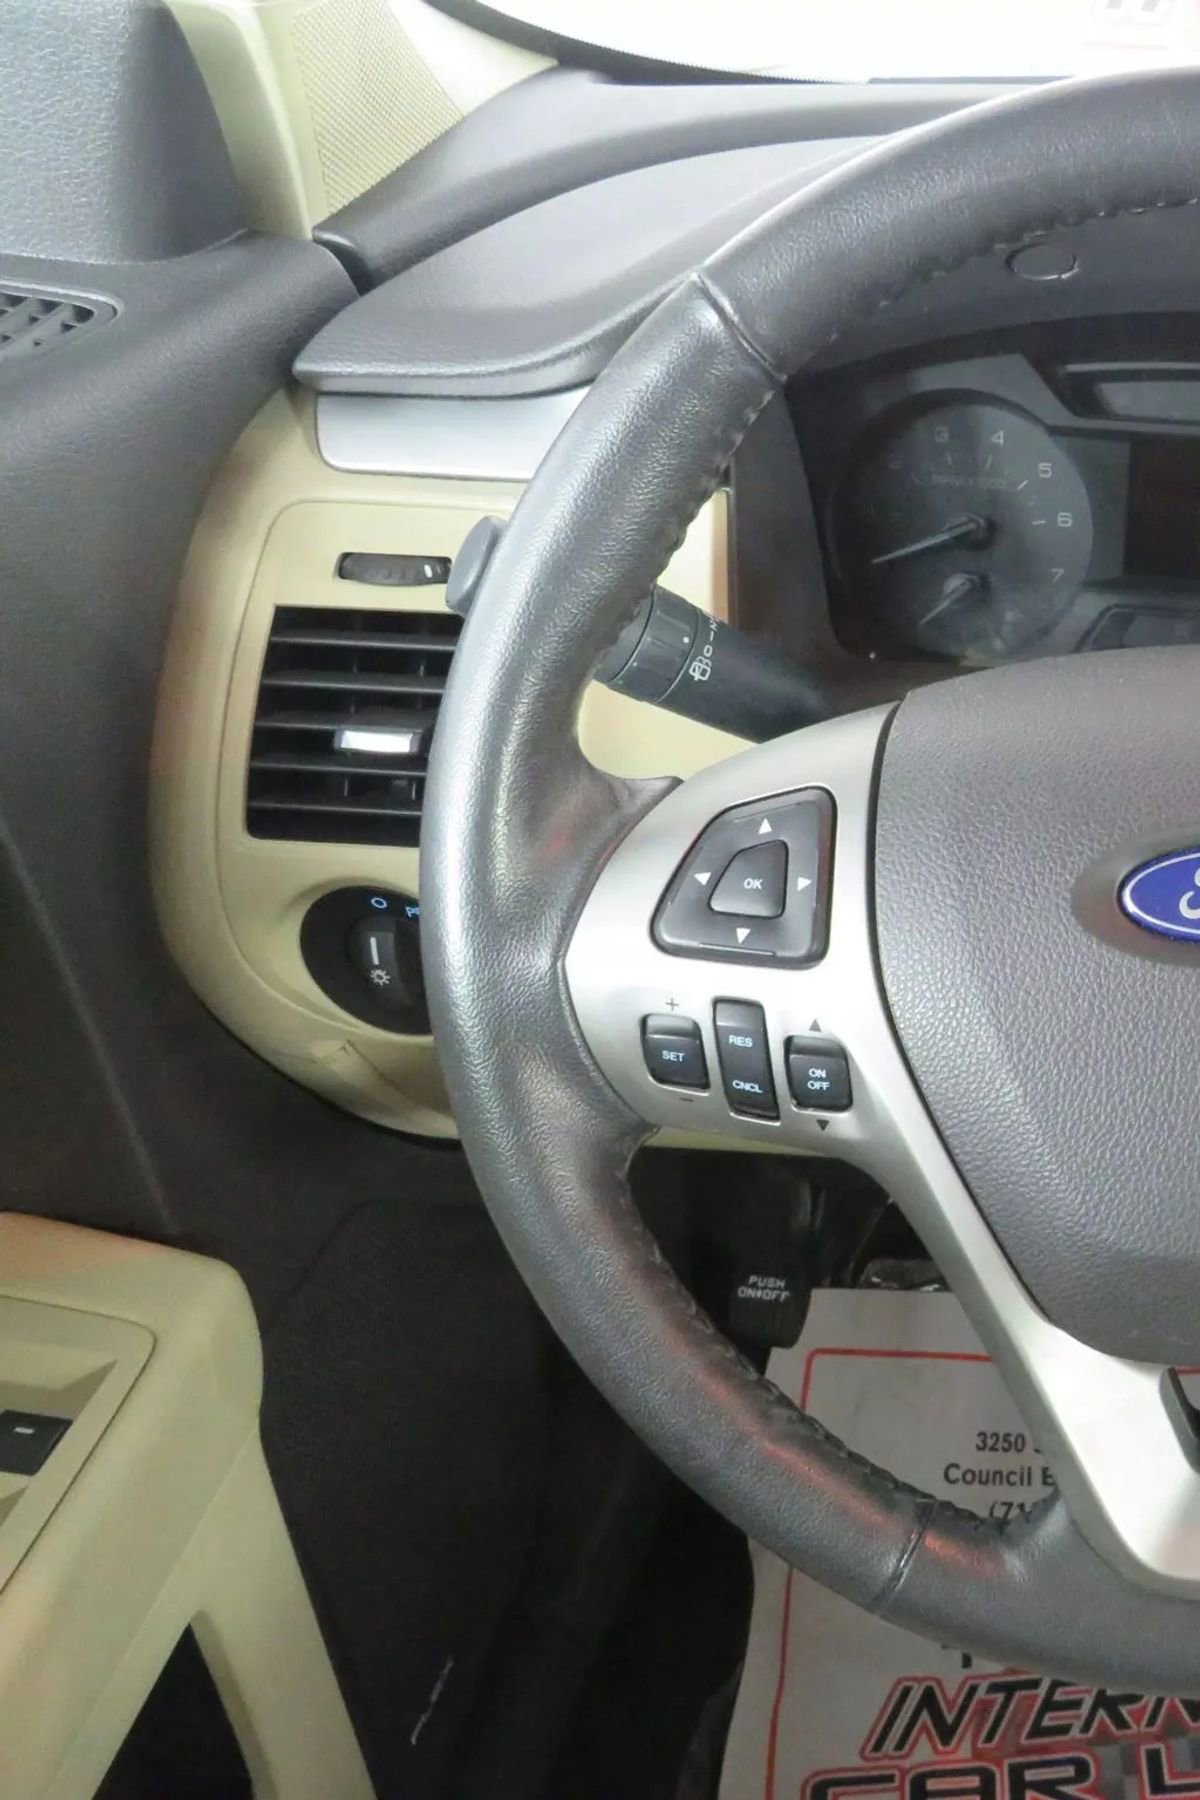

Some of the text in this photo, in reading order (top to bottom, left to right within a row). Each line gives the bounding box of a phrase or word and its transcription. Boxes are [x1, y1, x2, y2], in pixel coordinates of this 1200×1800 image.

[991, 430, 1005, 447] 4
[1038, 463, 1052, 478] 5
[1057, 512, 1073, 528] 6
[1050, 568, 1065, 583] 7
[743, 877, 763, 890] OK
[728, 1035, 754, 1048] RES
[662, 1050, 685, 1062] SET
[809, 1067, 827, 1079] ON
[732, 1079, 764, 1094] CNCL
[807, 1080, 830, 1092] OFF
[748, 1275, 787, 1289] PUSH
[975, 1431, 1027, 1453] 3250
[943, 1462, 1032, 1487] Council
